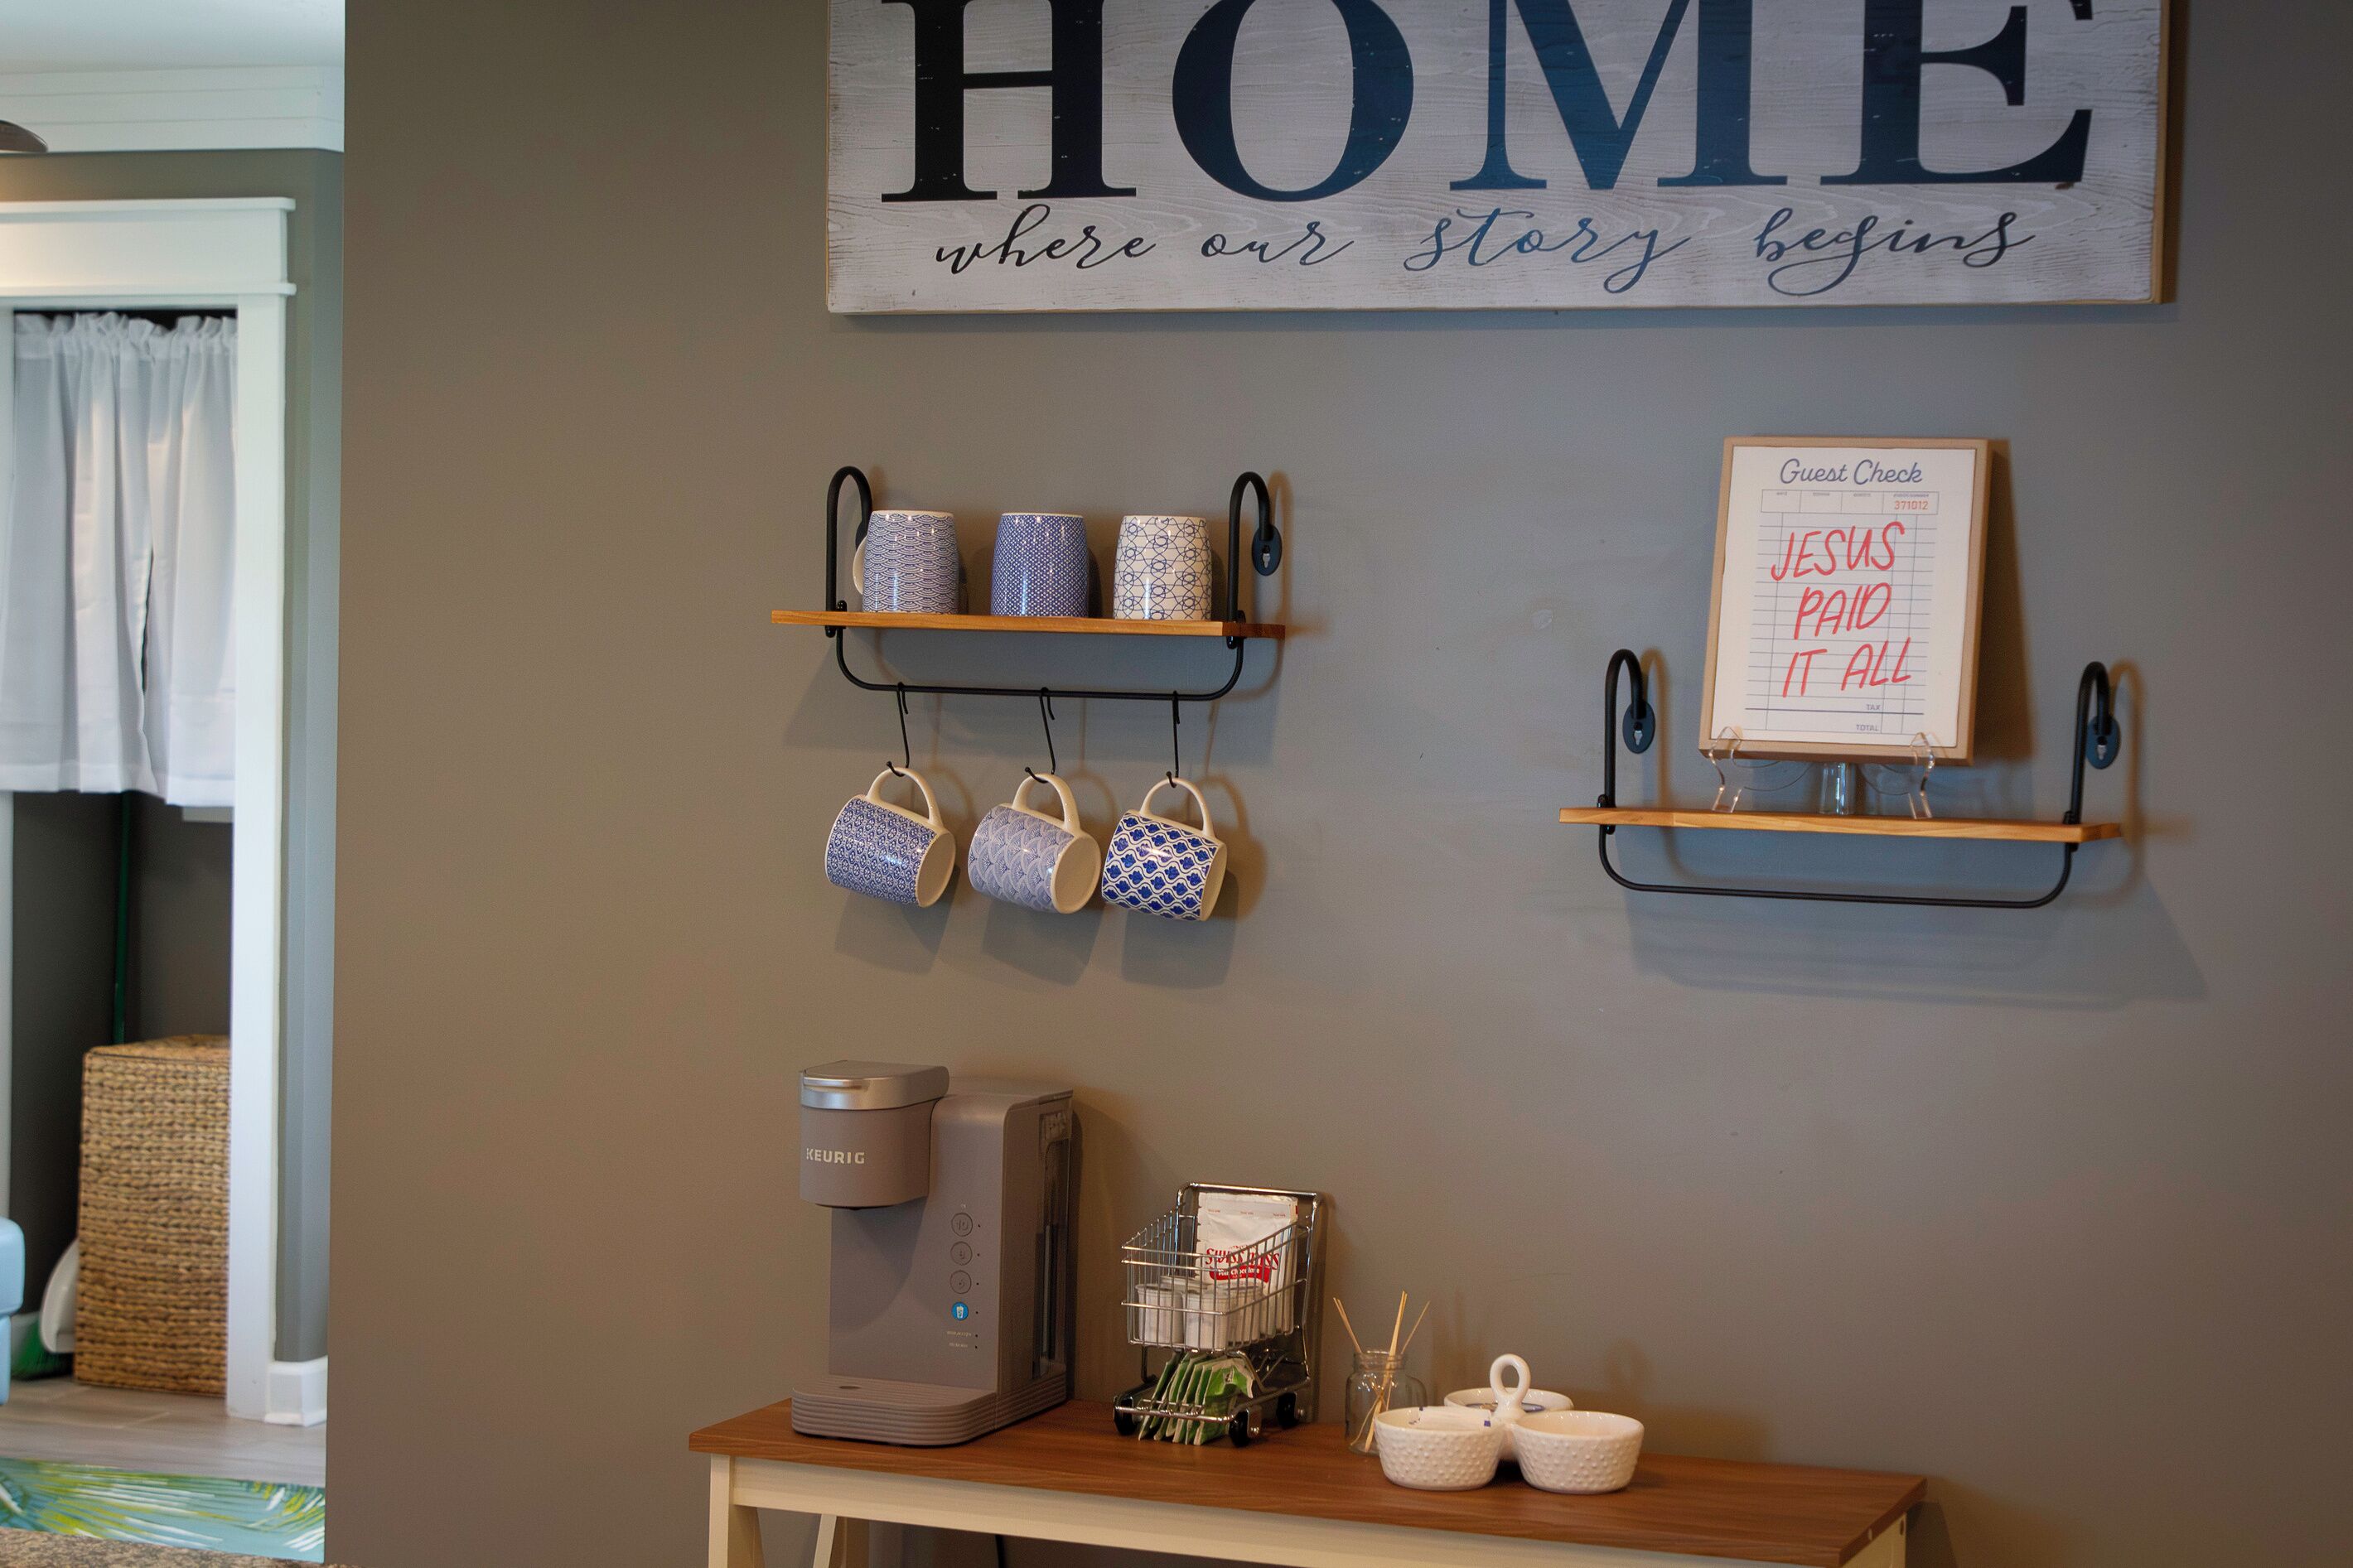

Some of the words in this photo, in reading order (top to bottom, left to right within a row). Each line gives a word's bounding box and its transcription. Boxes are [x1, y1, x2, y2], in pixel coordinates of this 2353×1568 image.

[881, 0, 2094, 202] HOME
[935, 203, 1157, 274] where
[1201, 220, 1354, 266] our
[1403, 206, 1692, 294] story
[1754, 207, 2036, 297] begins
[1780, 457, 1848, 485] Guest
[1853, 459, 1923, 485] Check
[1771, 521, 1906, 581] JESUS
[1793, 581, 1892, 640] PAID
[1781, 648, 1828, 698] IT
[1840, 636, 1911, 692] ALL
[806, 1147, 865, 1165] KEURIG
